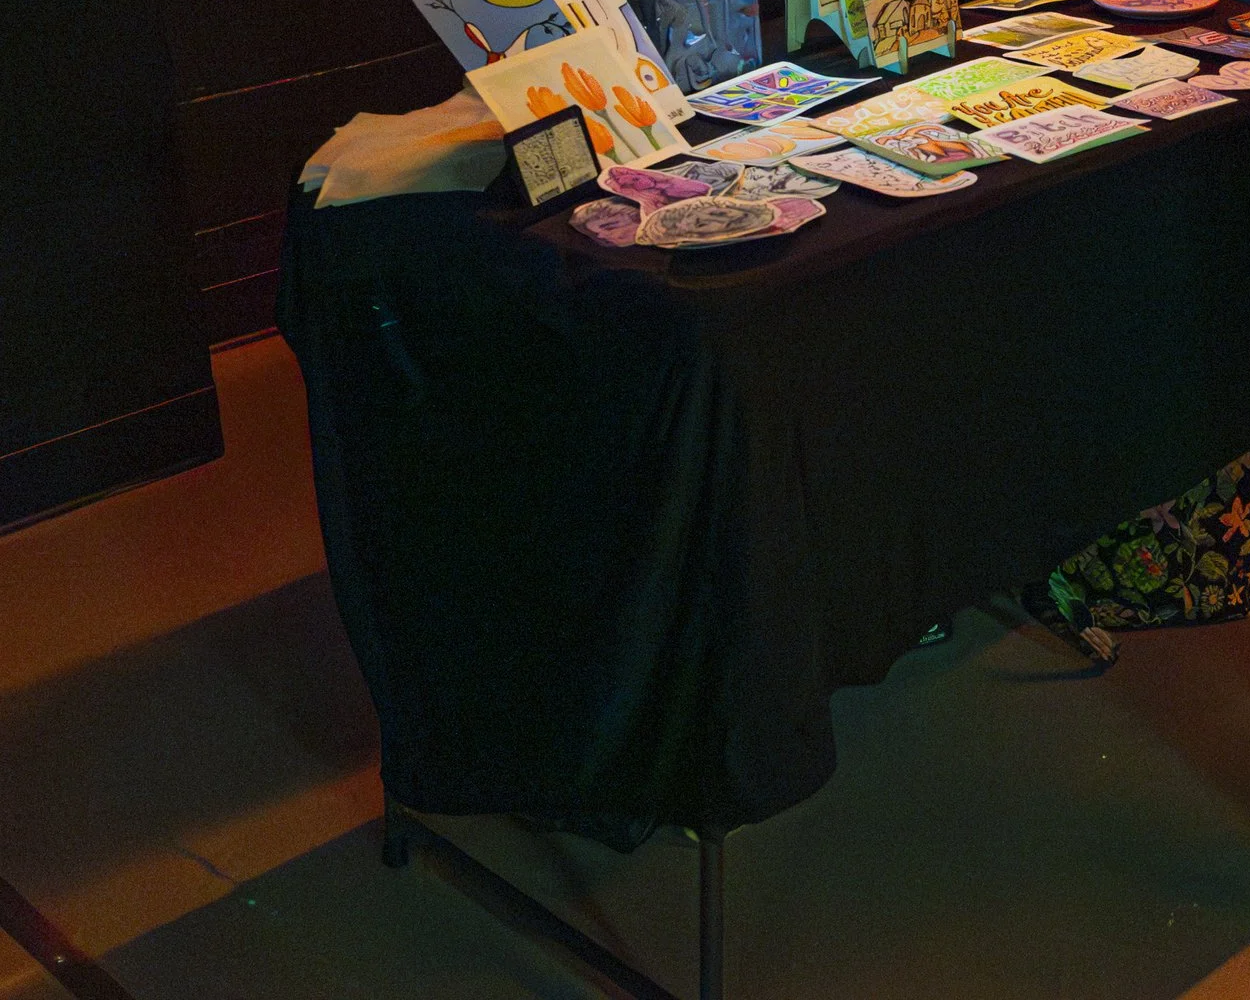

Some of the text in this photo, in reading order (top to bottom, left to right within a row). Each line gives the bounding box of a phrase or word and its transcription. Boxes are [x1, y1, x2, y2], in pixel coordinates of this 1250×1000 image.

[952, 101, 1009, 121] You
[998, 88, 1054, 109] Are
[995, 114, 1107, 144] Bitch
